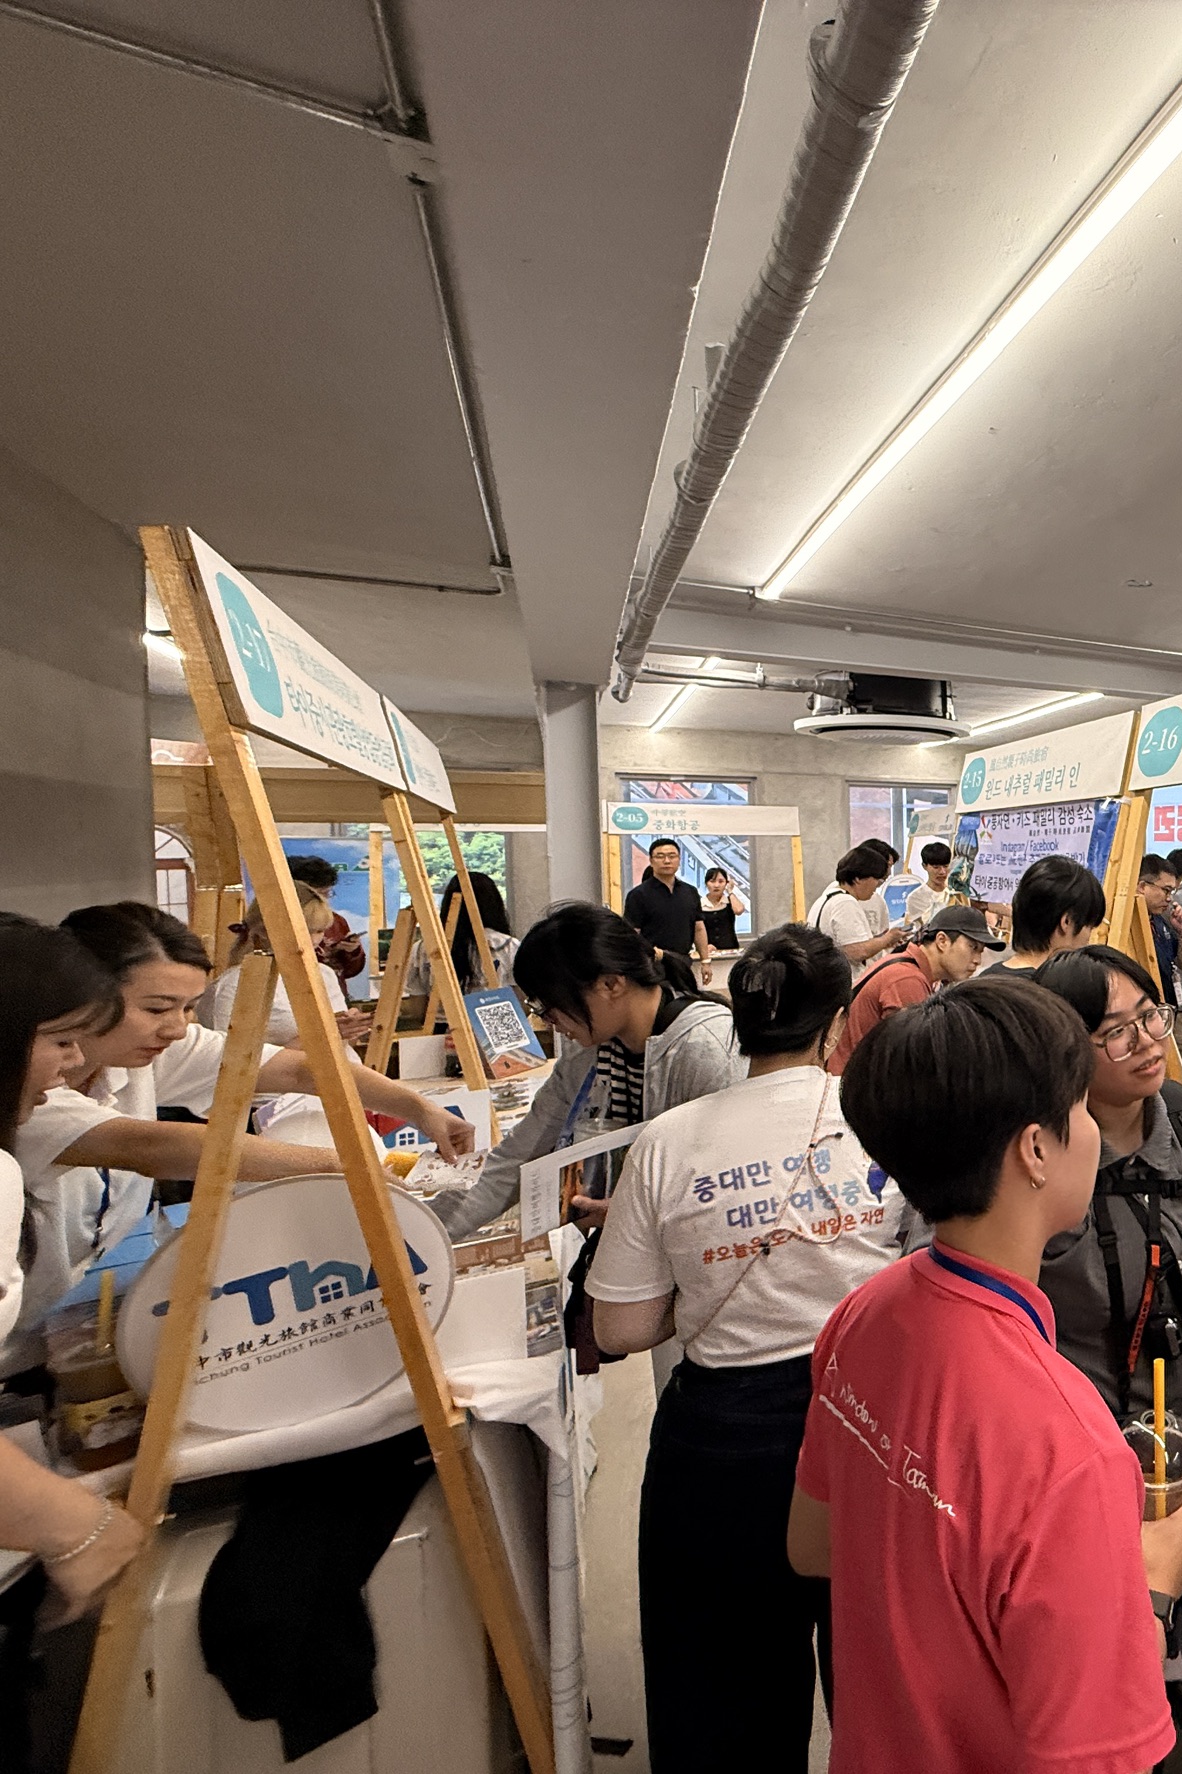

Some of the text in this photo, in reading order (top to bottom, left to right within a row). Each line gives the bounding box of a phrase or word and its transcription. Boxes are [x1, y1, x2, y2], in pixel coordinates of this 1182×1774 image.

[1141, 725, 1179, 754] 2-16
[963, 770, 982, 789] 2-15
[985, 778, 1001, 800] 윈드
[1033, 764, 1066, 793] 패밀리
[1069, 762, 1081, 788] 인
[616, 812, 643, 823] 2-05
[653, 819, 700, 831] 중화항공
[1058, 805, 1075, 826] 감성
[1030, 839, 1059, 852] Facebook
[693, 1149, 831, 1203] 중대만 여행
[726, 1180, 861, 1228] 대만 여행중
[811, 1214, 857, 1235] 내일은
[860, 1207, 884, 1224] 자연
[257, 1344, 304, 1366] Tourist
[309, 1329, 350, 1347] Hotel
